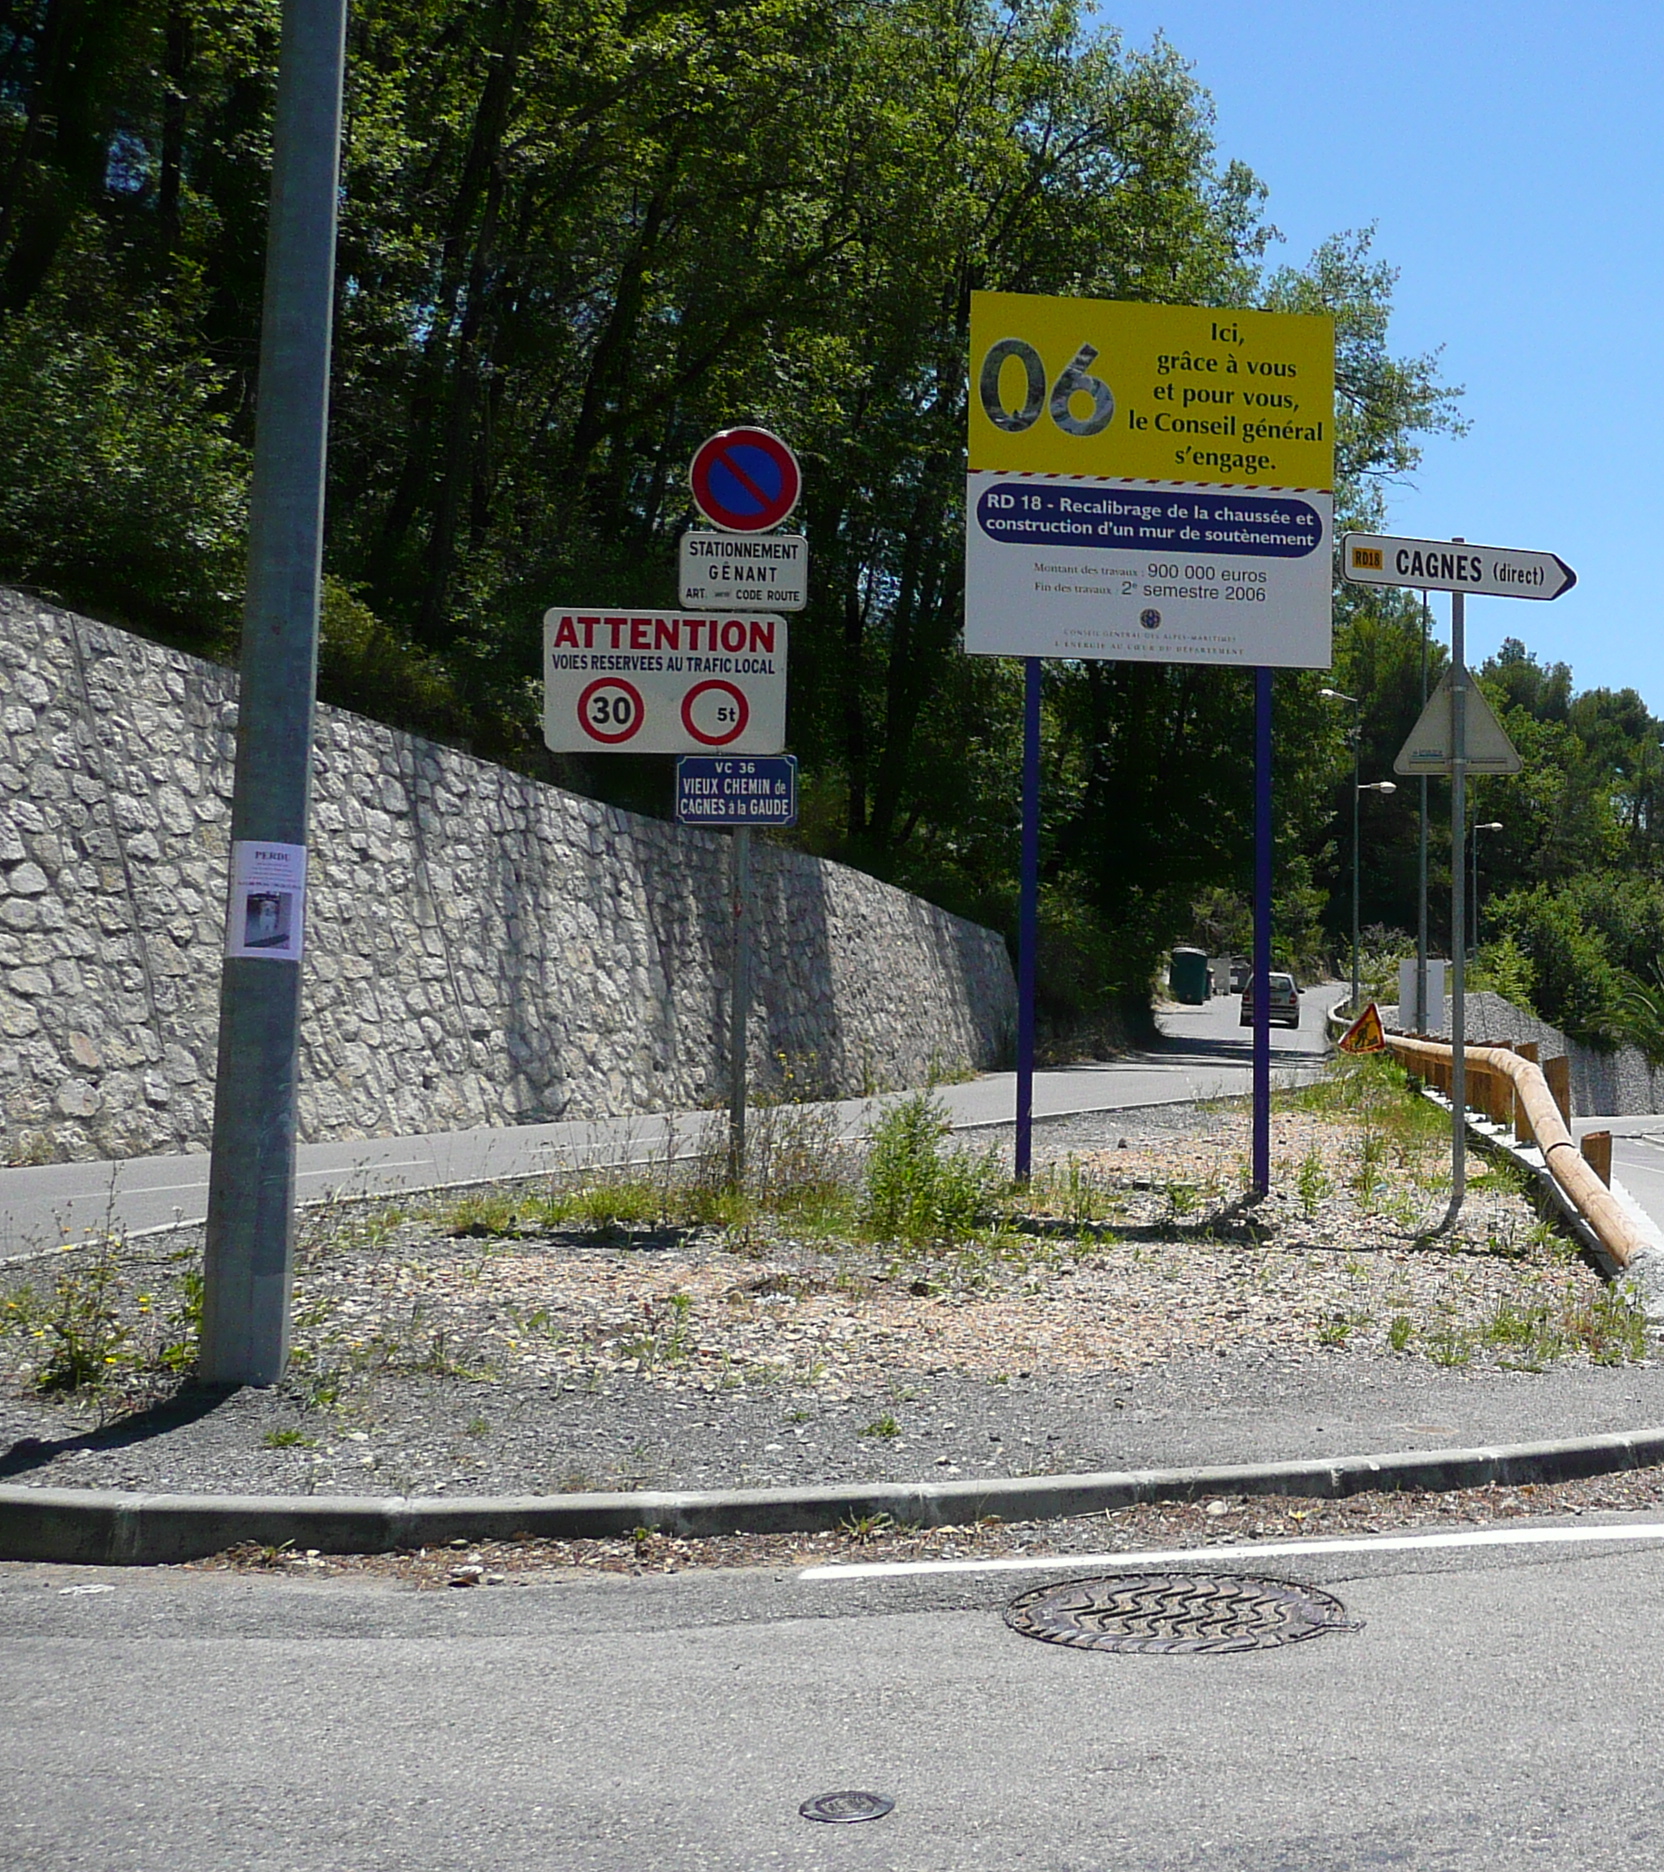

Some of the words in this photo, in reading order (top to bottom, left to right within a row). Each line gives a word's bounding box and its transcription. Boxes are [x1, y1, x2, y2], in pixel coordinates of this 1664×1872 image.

[1211, 322, 1245, 346] Ici,
[1157, 351, 1218, 375] grâce
[1226, 354, 1238, 374] à
[1246, 361, 1297, 378] vous
[979, 338, 1114, 437] 06
[1153, 383, 1175, 401] et
[1183, 387, 1235, 408] pour
[1243, 392, 1299, 412] vous,
[1129, 410, 1148, 430] le
[1154, 412, 1236, 436] Conseil
[1242, 418, 1323, 443] général
[987, 494, 1015, 509] RD
[1021, 496, 1042, 511] 18
[1060, 498, 1162, 520] Recalibrage
[1167, 504, 1189, 519] de
[1194, 506, 1209, 520] la
[1214, 507, 1291, 524] chaussée
[1296, 514, 1314, 526] et
[986, 519, 1093, 535] construction
[1098, 522, 1134, 537] d'un
[1139, 527, 1176, 539] mur
[1179, 526, 1200, 541] de
[1205, 529, 1315, 547] soutènement
[689, 541, 799, 559] STATIONNEMENT
[709, 561, 778, 582] GÊNANT
[1034, 562, 1078, 574] Montant
[1081, 565, 1098, 575] des
[1101, 567, 1138, 577] travaux
[1148, 563, 1179, 579] 900
[1185, 566, 1216, 581] 000
[1221, 570, 1267, 583] euros
[1354, 551, 1381, 567] RD18
[1395, 549, 1483, 583] CAGNES
[1493, 561, 1545, 587] (direct)
[735, 589, 763, 600] CODE
[767, 590, 800, 601] ROUTE
[1034, 581, 1051, 592] Fin
[1054, 583, 1072, 593] des
[1075, 585, 1112, 595] travaux
[1143, 585, 1219, 600] semestre
[1225, 586, 1266, 602] 2006
[553, 616, 775, 653] ATTENTION
[552, 654, 588, 670] VOIES
[591, 655, 663, 672] RESERVEES
[666, 657, 683, 672] AU
[686, 657, 731, 674] TRAFIC
[735, 658, 775, 674] LOCAL
[591, 696, 632, 725] 30
[717, 707, 736, 723] 5t
[715, 762, 733, 774] VC
[739, 762, 755, 774] 36
[683, 778, 718, 795] VIEUX
[724, 778, 770, 795] CHEMIN
[775, 780, 786, 795] de
[680, 798, 726, 815] CAGNES
[737, 799, 746, 815] la
[750, 799, 789, 816] GAUDE
[255, 851, 291, 861] PERDU
